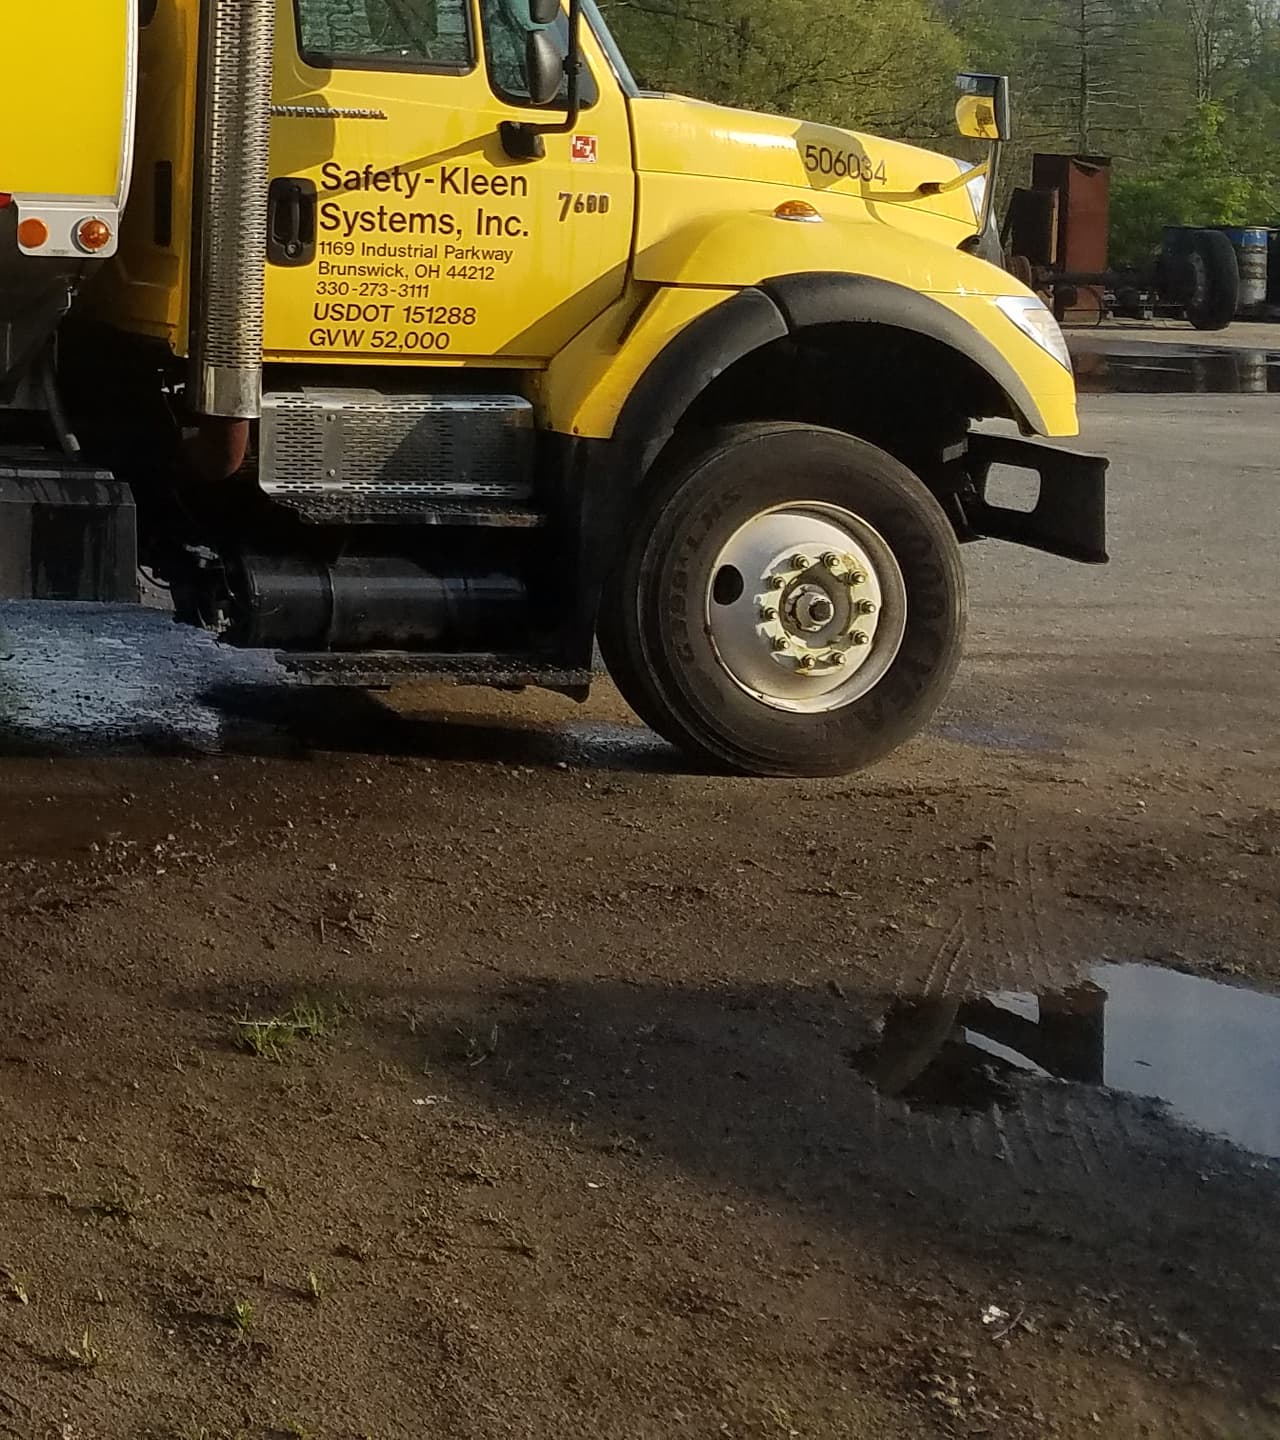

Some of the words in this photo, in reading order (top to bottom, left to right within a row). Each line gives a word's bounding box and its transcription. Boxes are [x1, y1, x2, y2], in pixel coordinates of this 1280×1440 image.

[804, 145, 888, 186] 506034
[320, 162, 529, 199] Safety-Kleen
[558, 192, 609, 223] 7600
[319, 203, 463, 241] Systems,
[476, 208, 530, 237] Inc.
[319, 241, 355, 257] 1169
[361, 242, 438, 259] Industrial
[444, 245, 514, 264] Parkway
[318, 262, 409, 280] Brunswick,
[415, 264, 441, 279] OH
[446, 266, 496, 281] 44212
[316, 282, 430, 298] 330-273-3111
[313, 303, 396, 323] USDOT
[403, 305, 477, 325] 151288
[309, 328, 365, 348] GVW
[370, 330, 450, 353] 52,000
